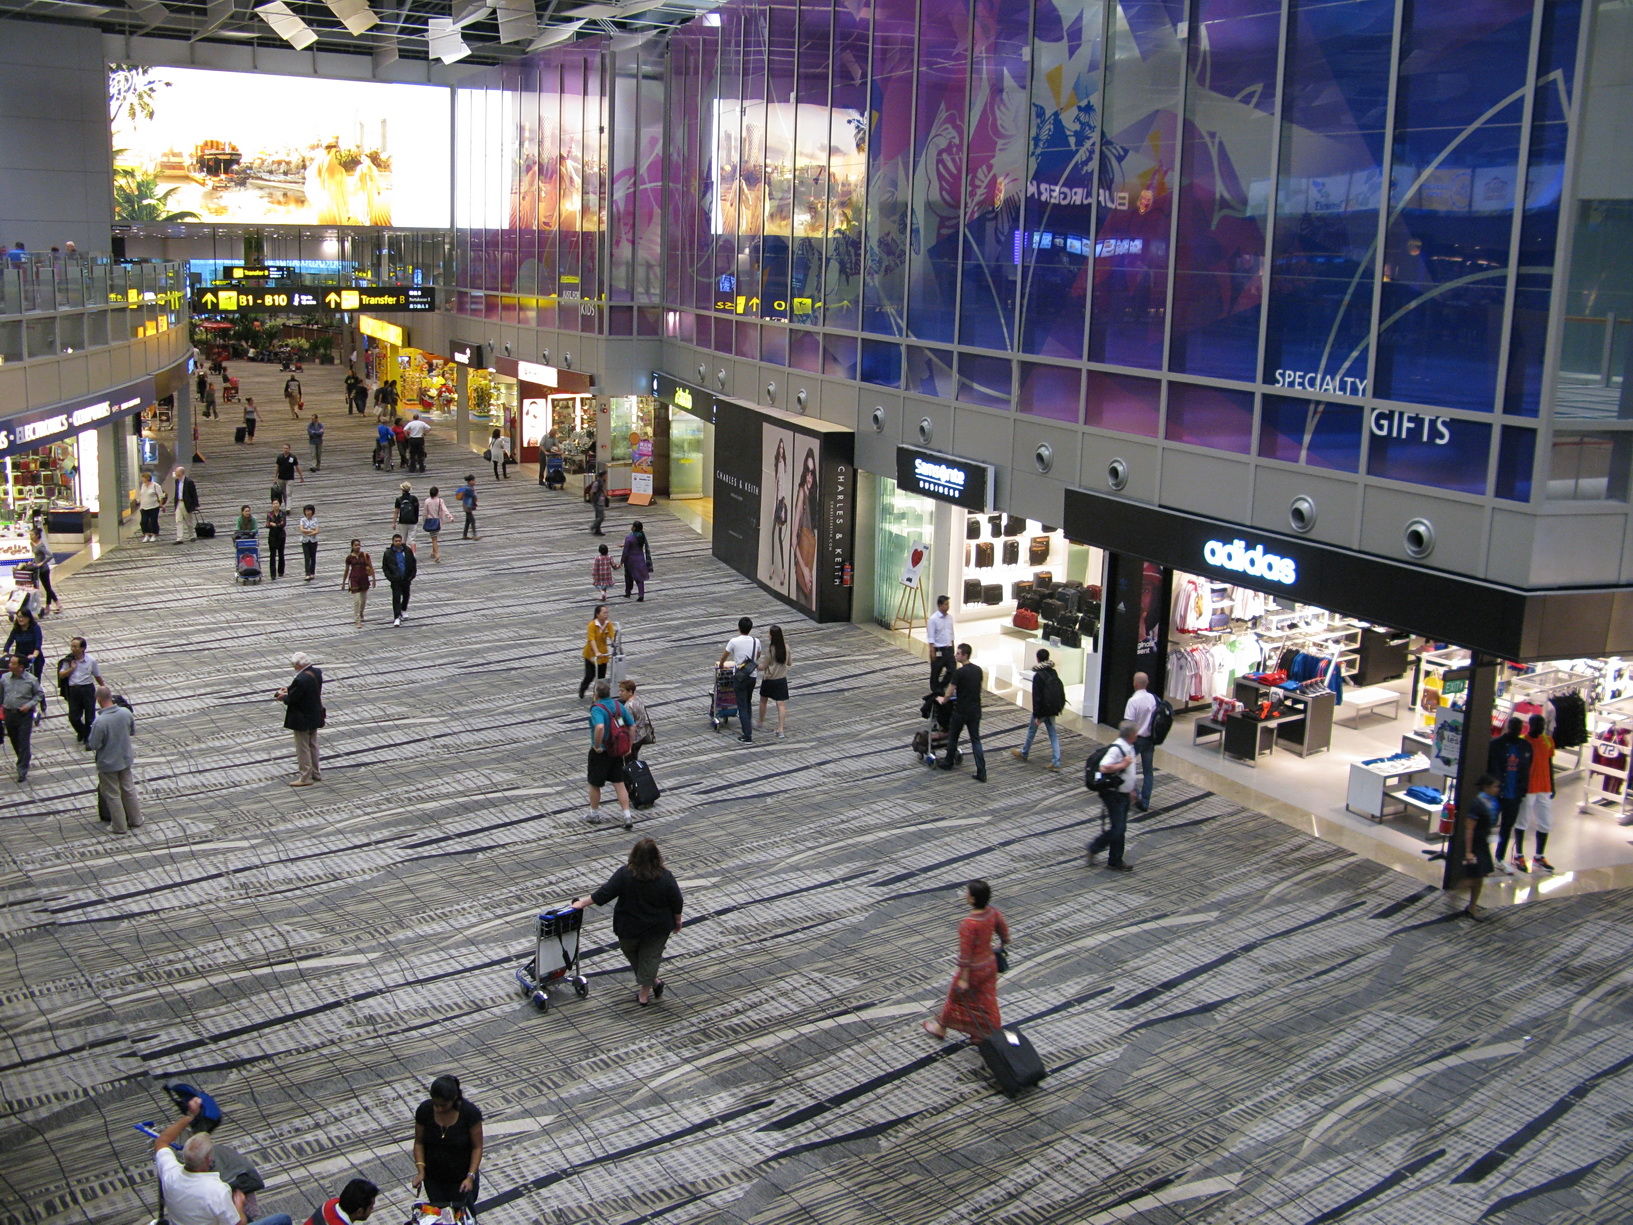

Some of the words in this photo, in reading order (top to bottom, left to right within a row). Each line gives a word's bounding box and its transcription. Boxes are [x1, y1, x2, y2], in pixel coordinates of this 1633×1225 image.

[239, 295, 253, 306] B1
[264, 295, 287, 306] B10
[361, 295, 397, 305] Transfer
[399, 296, 405, 304] B
[581, 303, 595, 316] KIDS
[1275, 369, 1367, 398] SPECIALTY
[16, 414, 69, 445] ELECTRONICS
[1371, 408, 1451, 445] GIFTS
[716, 470, 737, 487] CHARLES
[739, 480, 743, 489] &
[744, 482, 759, 496] KEITH
[836, 466, 846, 524] CHARLES
[919, 480, 960, 498] BUSINESS
[834, 548, 842, 585] KEITH
[1203, 539, 1296, 585] adidas
[1445, 682, 1460, 693] EXIT
[1600, 743, 1615, 756] 72
